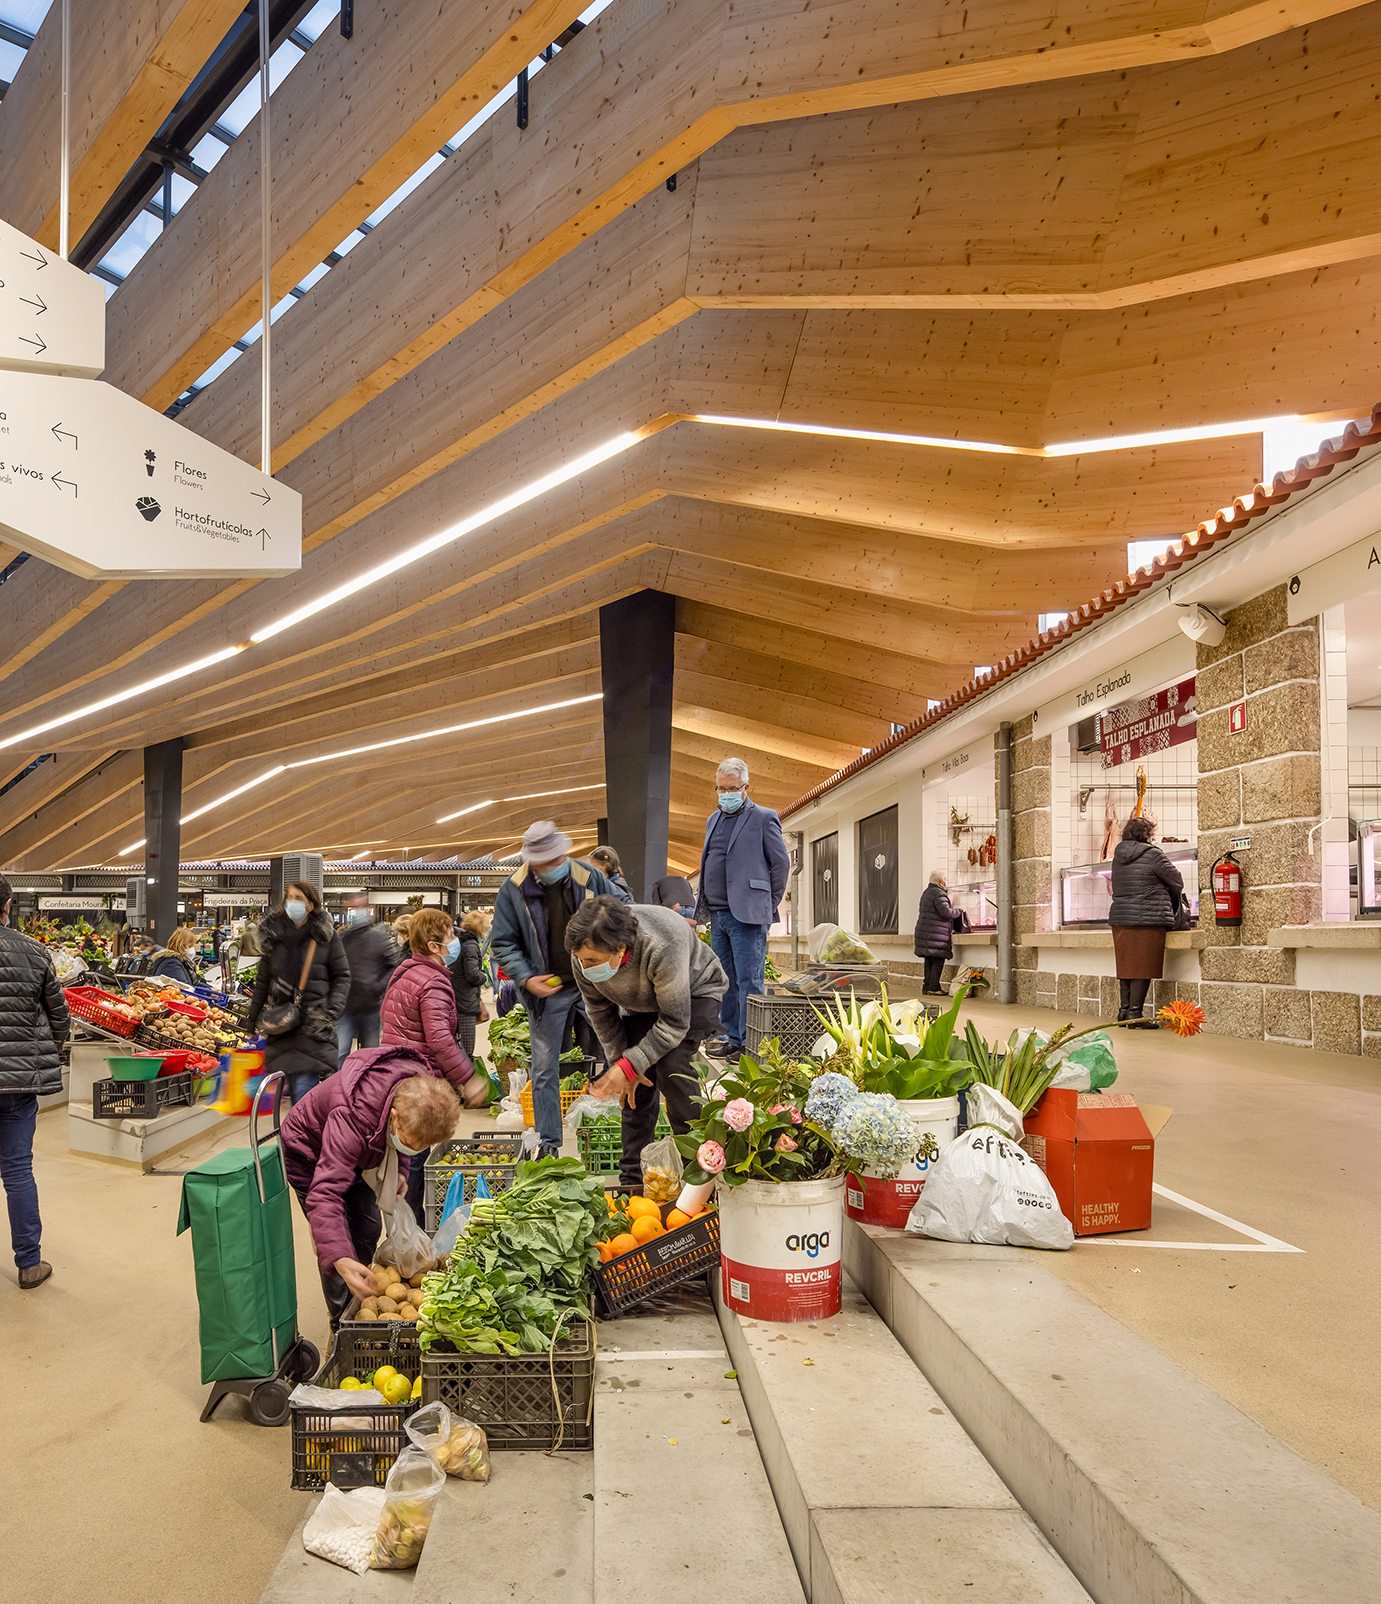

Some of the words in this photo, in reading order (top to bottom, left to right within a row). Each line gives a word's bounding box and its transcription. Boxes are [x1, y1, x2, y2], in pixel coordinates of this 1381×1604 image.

[11, 464, 44, 481] vivos
[174, 460, 207, 480] Flores
[173, 474, 204, 491] Flowers
[174, 506, 253, 537] Hortofrutícolas
[175, 518, 240, 544] Fruits&Vegetables
[1367, 546, 1381, 570] A
[1076, 690, 1094, 707] Talho
[1096, 669, 1131, 698] Esplanada
[1104, 728, 1128, 749] TALHO
[1129, 709, 1176, 741] ESPLANADA
[44, 900, 81, 908] Confeitaria
[204, 897, 238, 906] Frigideiras
[1081, 1202, 1120, 1215] HEALTHY
[1081, 1217, 1090, 1227] IS
[1092, 1214, 1121, 1226] HAPPY.
[786, 1231, 830, 1258] arga
[785, 1269, 832, 1284] REVCRIL
